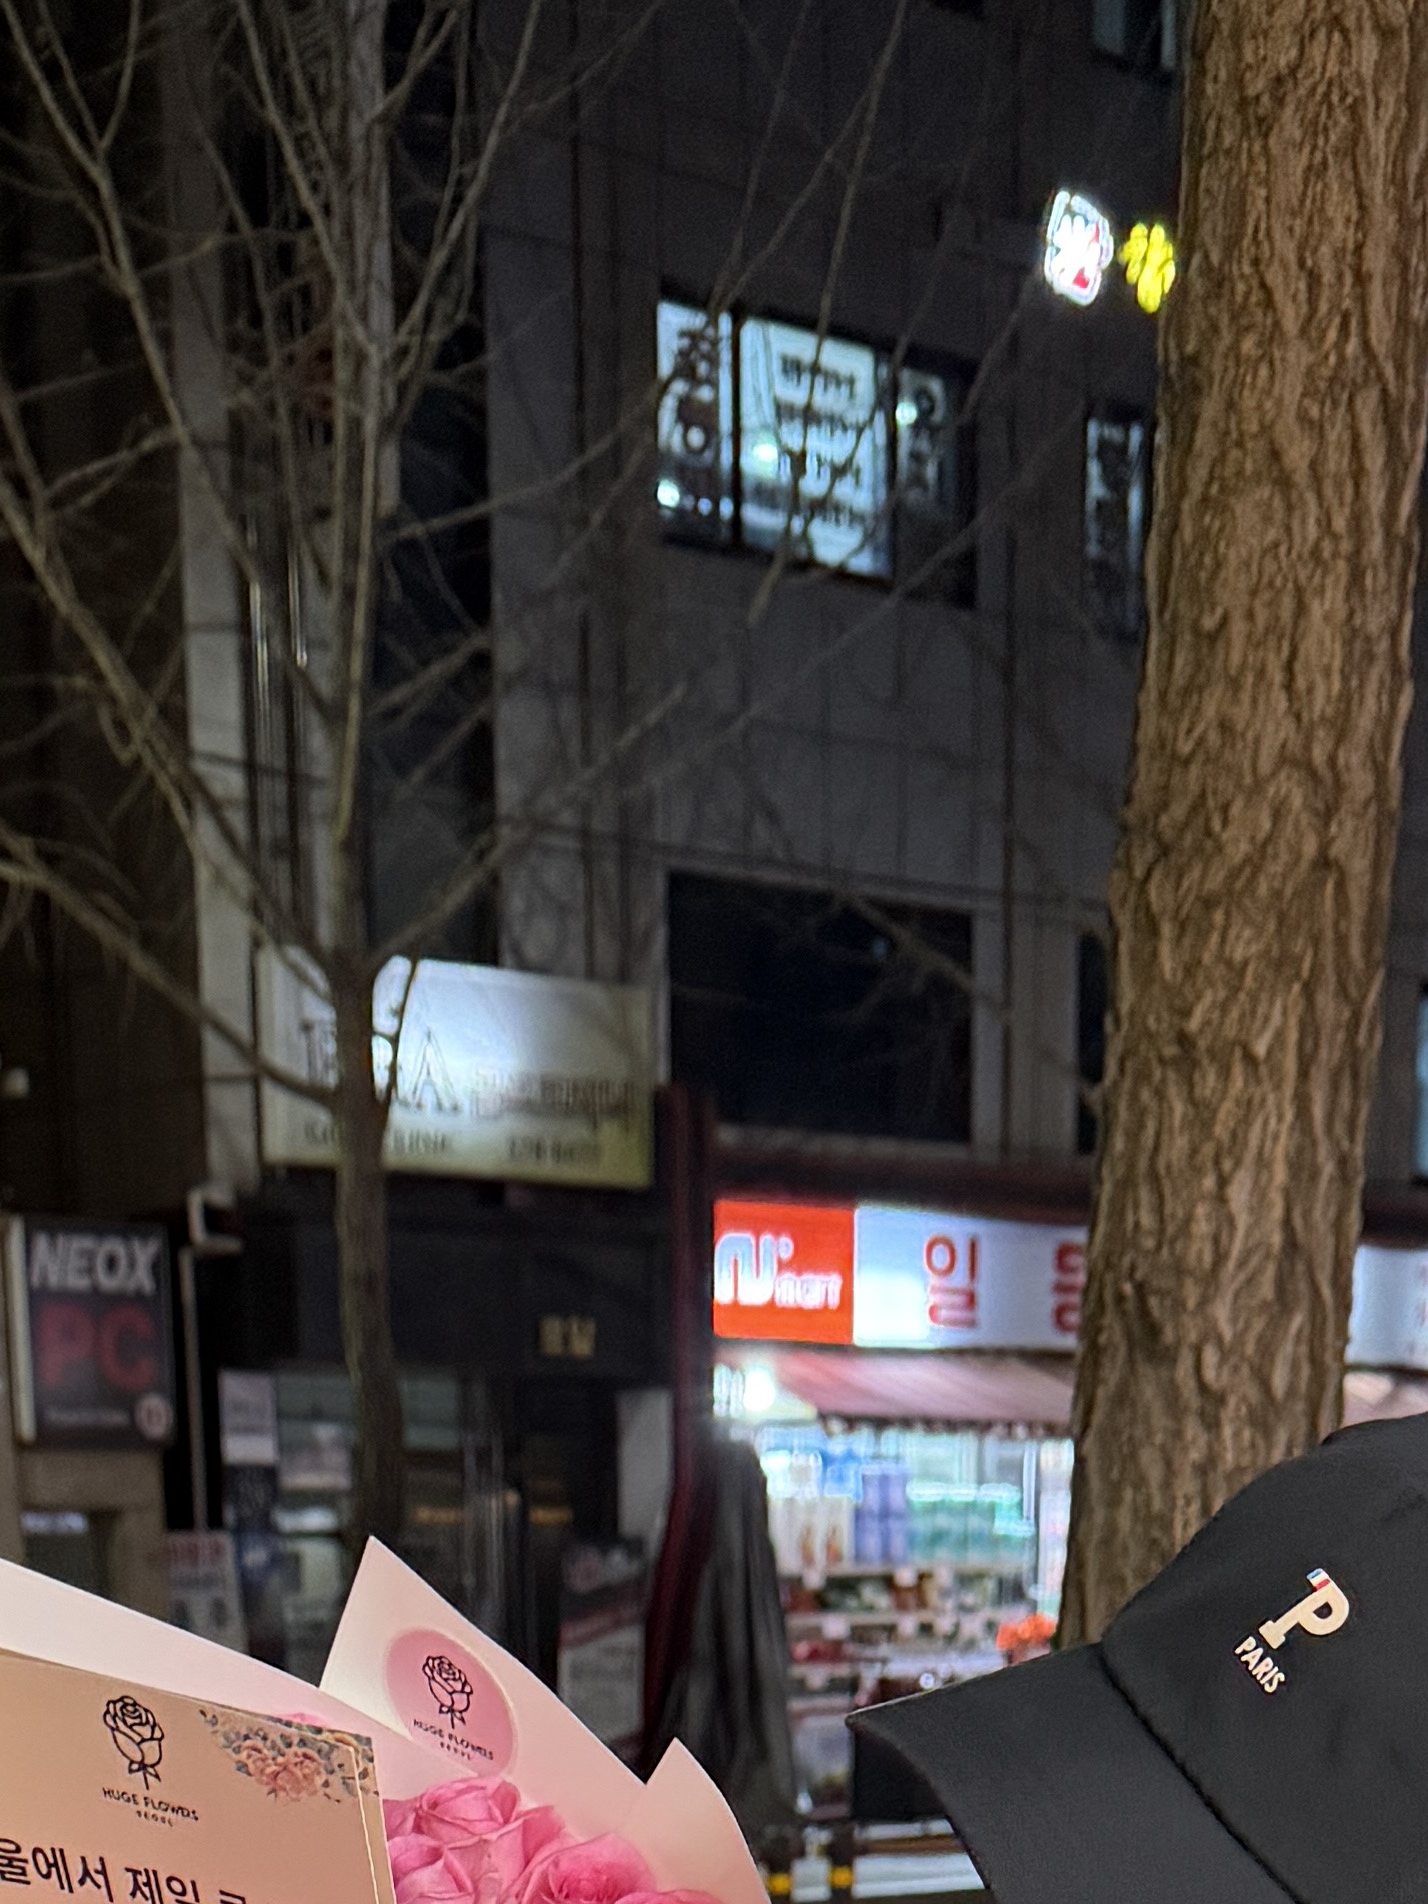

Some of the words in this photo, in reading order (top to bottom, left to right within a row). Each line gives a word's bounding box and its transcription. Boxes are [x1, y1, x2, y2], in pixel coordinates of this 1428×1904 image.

[31, 1232, 162, 1296] NEOX
[39, 1303, 158, 1391] PC
[1258, 1567, 1350, 1650] P
[1234, 1636, 1286, 1693] PARIS
[102, 1787, 139, 1806] HUGE
